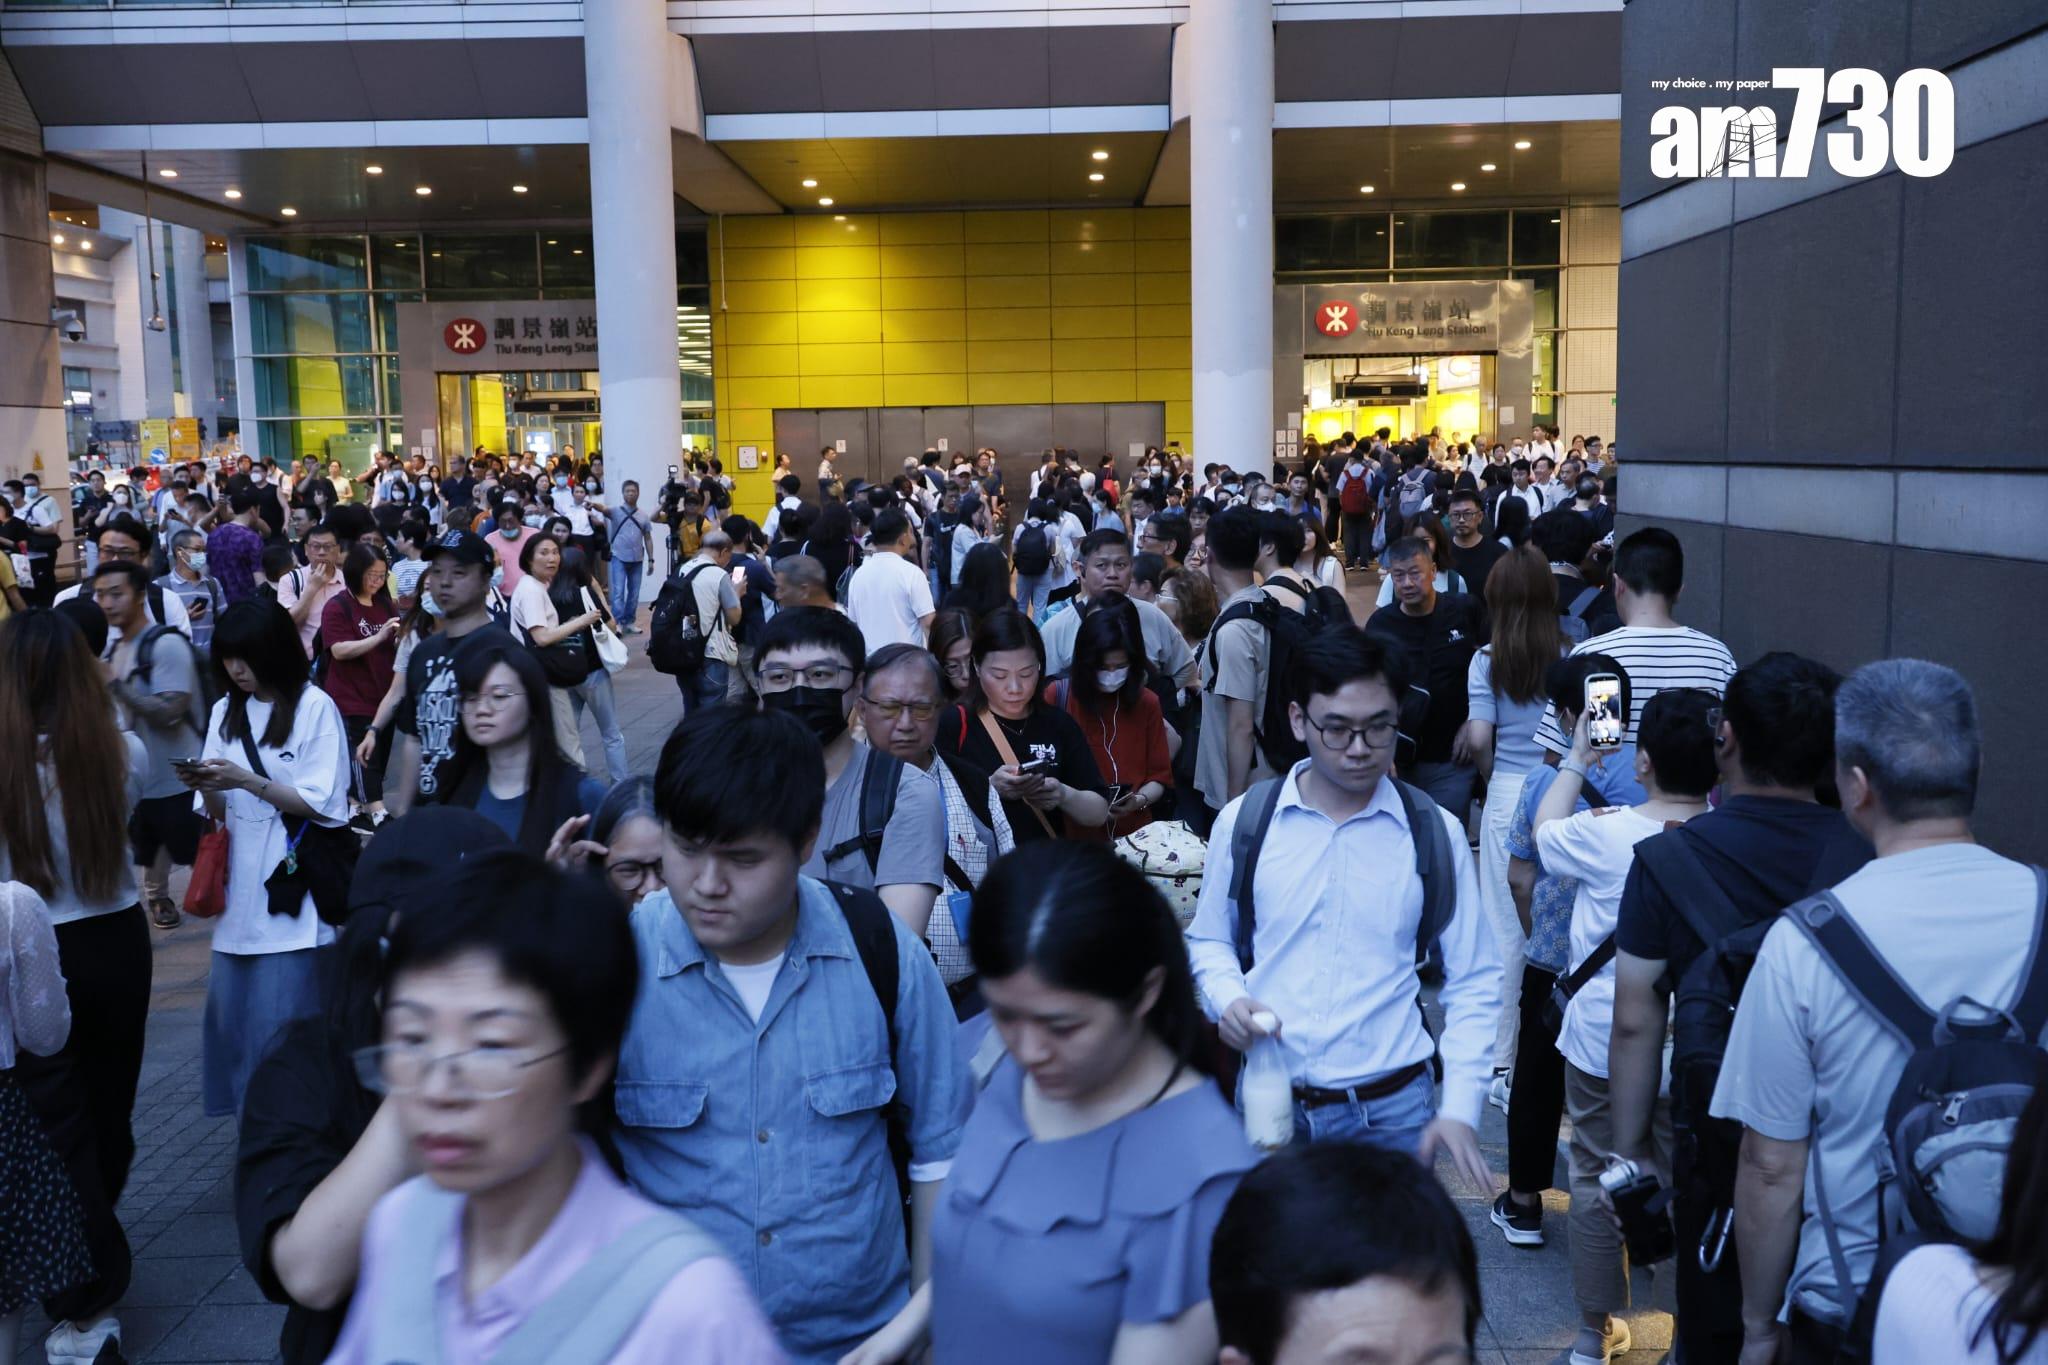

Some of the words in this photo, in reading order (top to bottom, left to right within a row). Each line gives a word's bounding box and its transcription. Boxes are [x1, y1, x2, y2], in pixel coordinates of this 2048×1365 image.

[494, 316, 597, 339] 調景嶺站
[1386, 327, 1414, 339] Keng
[1447, 323, 1487, 336] Station
[494, 343, 512, 354] Tiu
[514, 343, 543, 356] Keng
[545, 342, 572, 356] Leng
